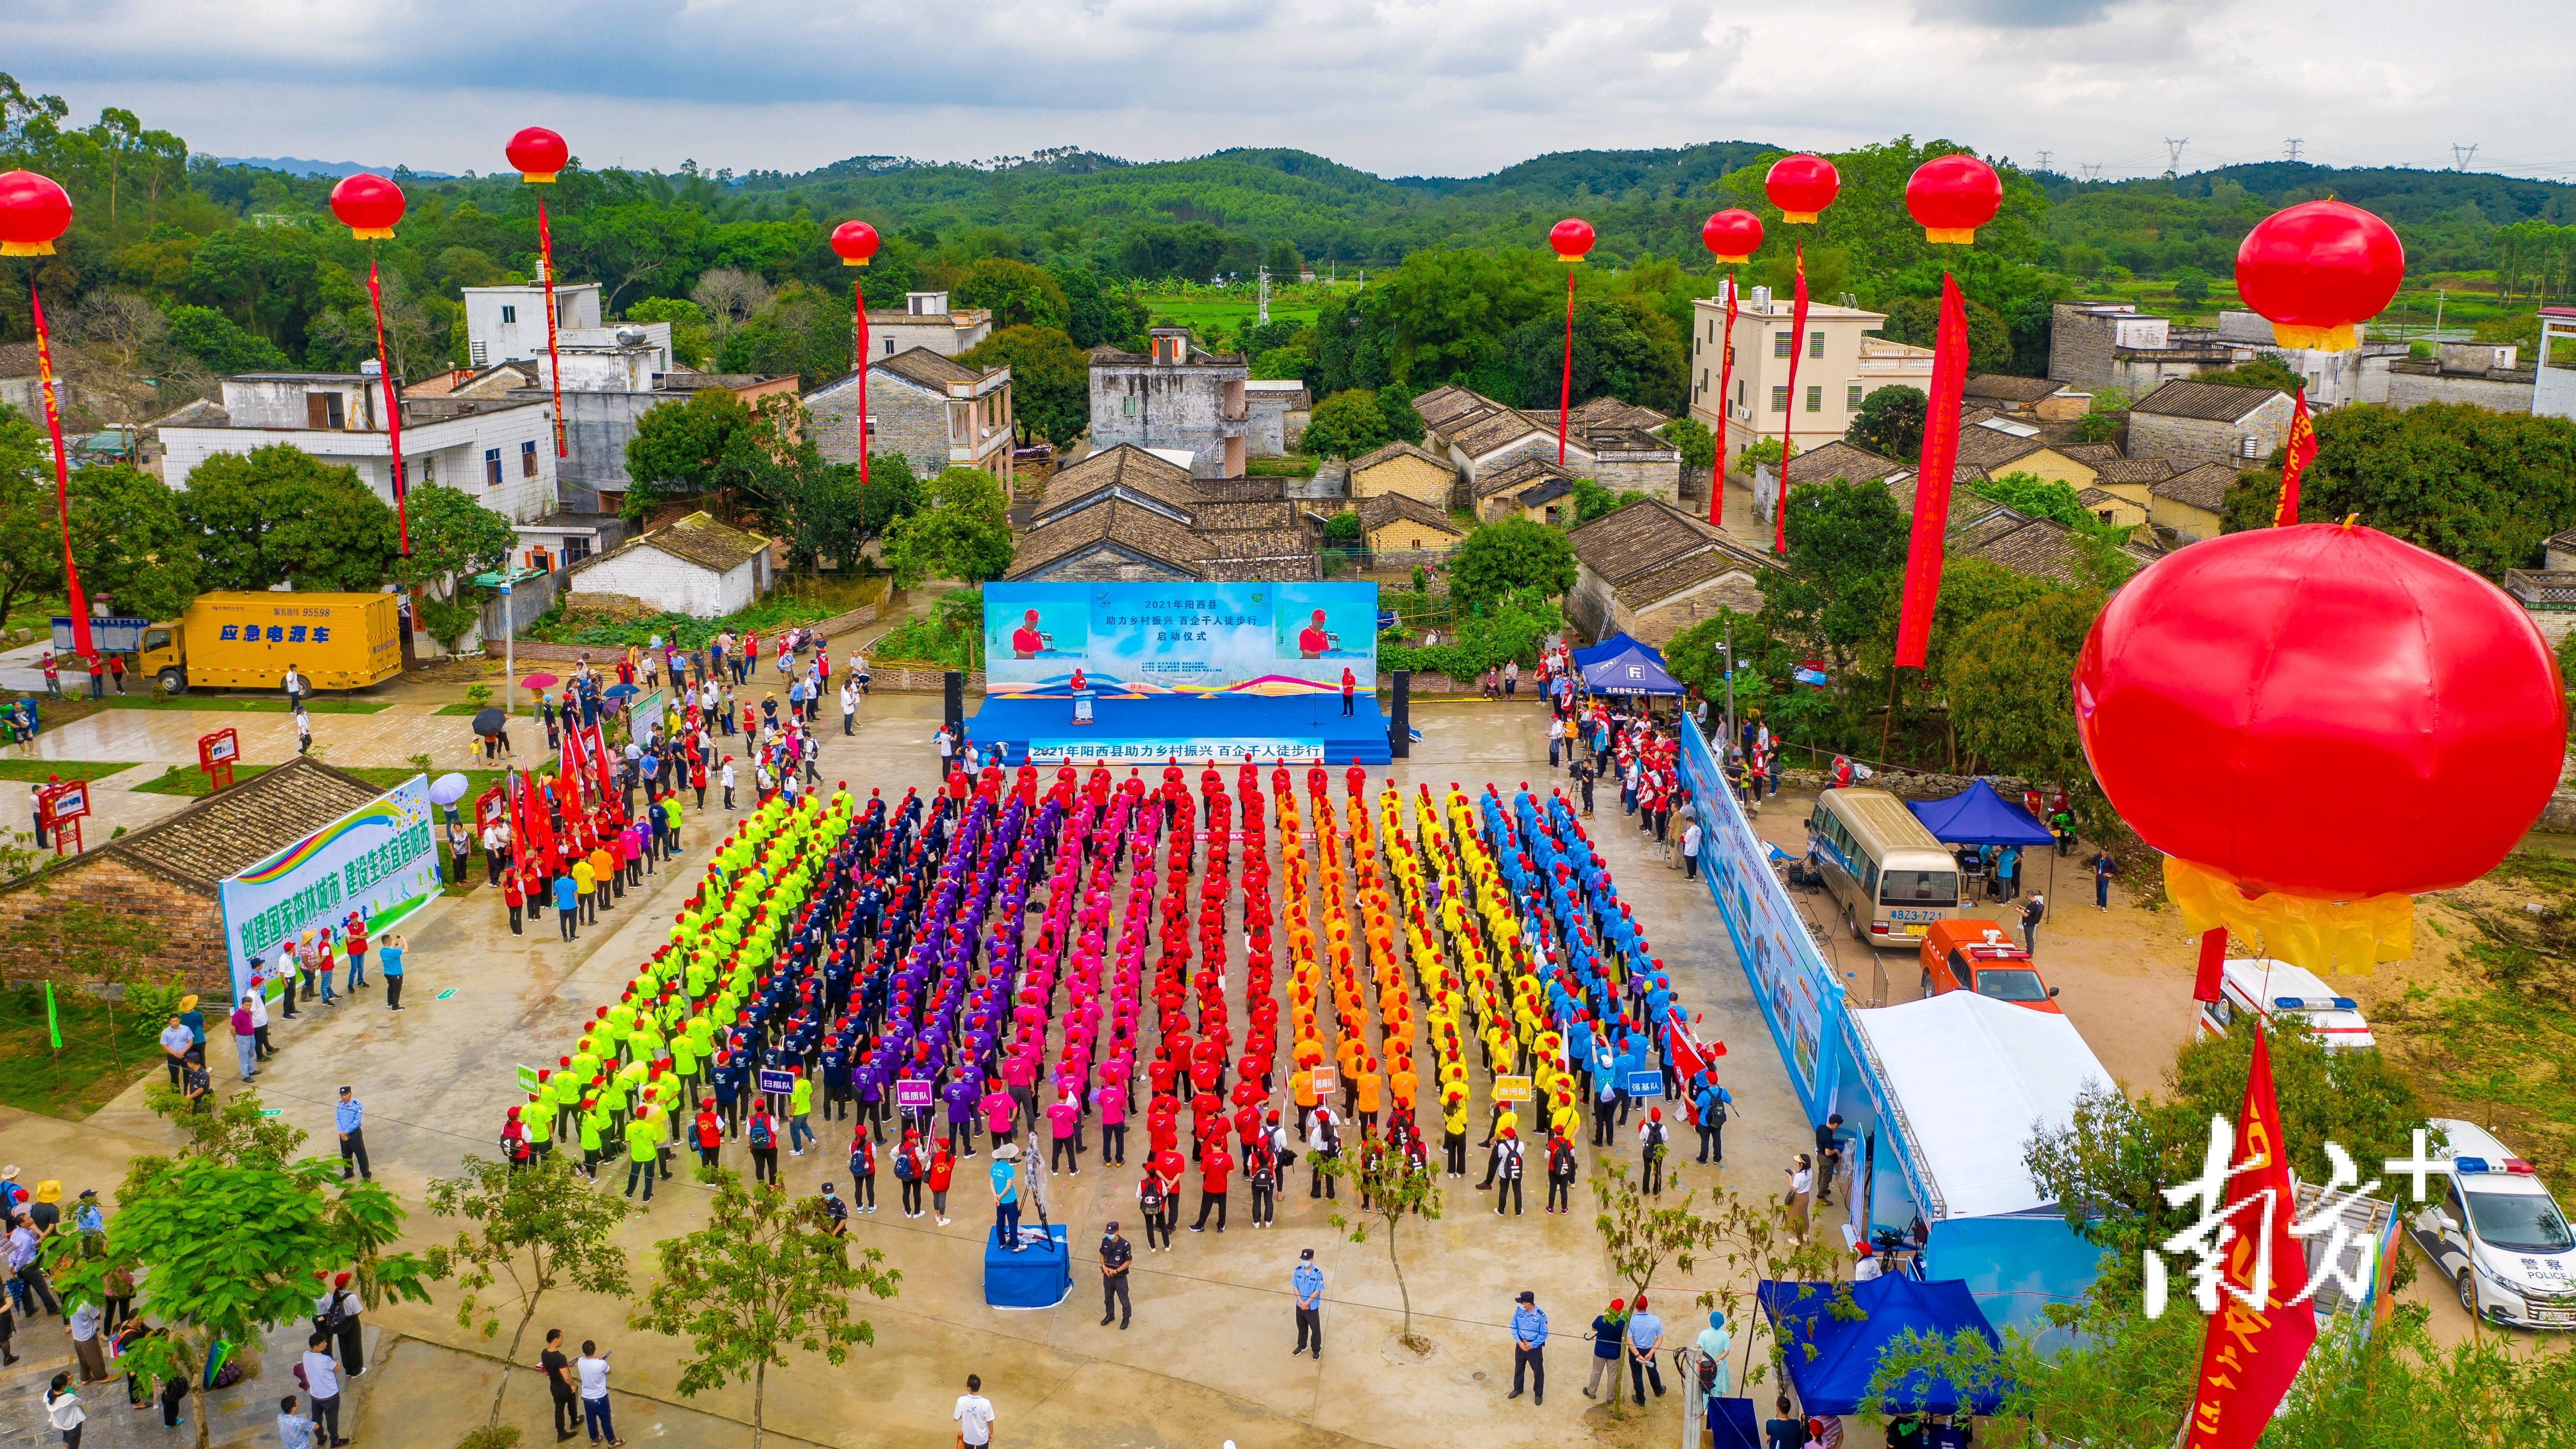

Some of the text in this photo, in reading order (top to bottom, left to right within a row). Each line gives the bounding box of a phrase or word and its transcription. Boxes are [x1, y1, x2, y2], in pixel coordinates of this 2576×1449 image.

[1146, 600, 1218, 610] 2021年阳西县
[302, 608, 330, 617] 95598
[1106, 616, 1257, 625] 助力乡村振兴 百企千人徒步行
[219, 624, 330, 643] 应急电源车
[1157, 631, 1207, 641] 启动仪式
[1219, 745, 1320, 757] 百企千人徒步行
[242, 818, 432, 960] 创建国家森林城市 建设生态宜居阳西
[764, 1079, 791, 1090] 扫黑队
[1316, 1078, 1334, 1089] 招商队
[1632, 1082, 1659, 1091] 强基队
[901, 1091, 929, 1101] 提质队
[1499, 1086, 1527, 1096] 治污队
[1399, 1127, 1407, 1145] FILA
[2520, 1258, 2563, 1270] 警察
